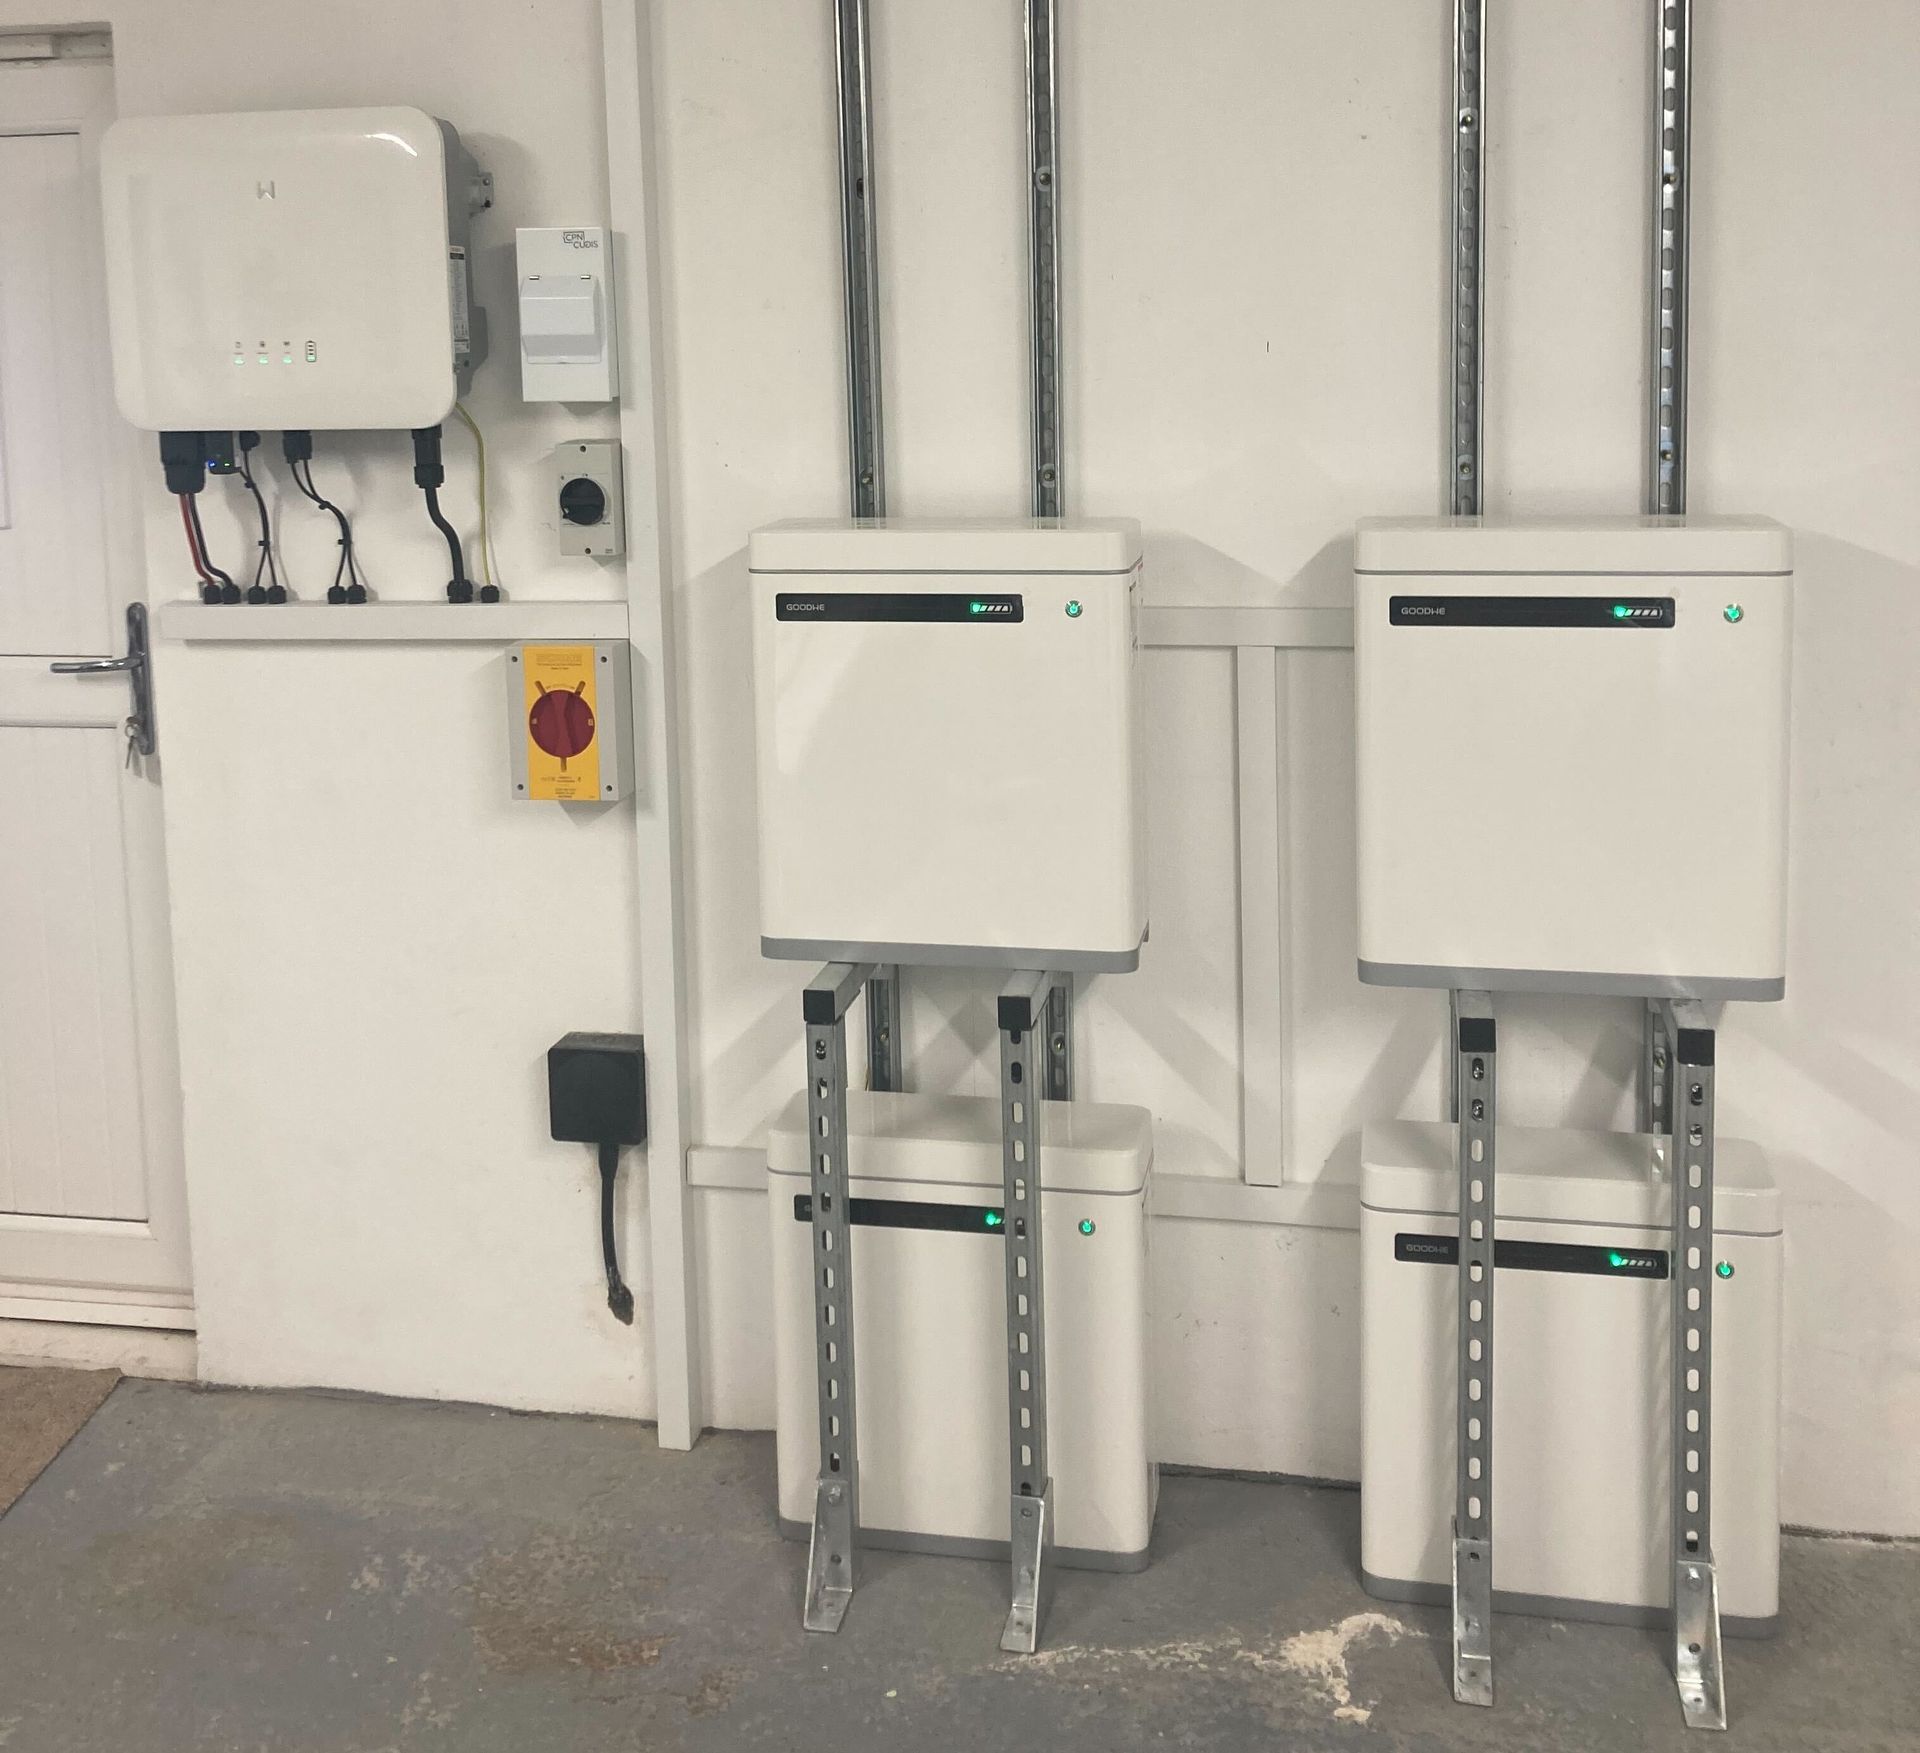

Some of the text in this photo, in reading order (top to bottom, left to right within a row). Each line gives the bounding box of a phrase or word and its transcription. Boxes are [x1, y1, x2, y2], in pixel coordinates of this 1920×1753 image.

[565, 233, 584, 242] CPN
[786, 603, 825, 612] GOODWE
[1401, 607, 1446, 616] GOODWE
